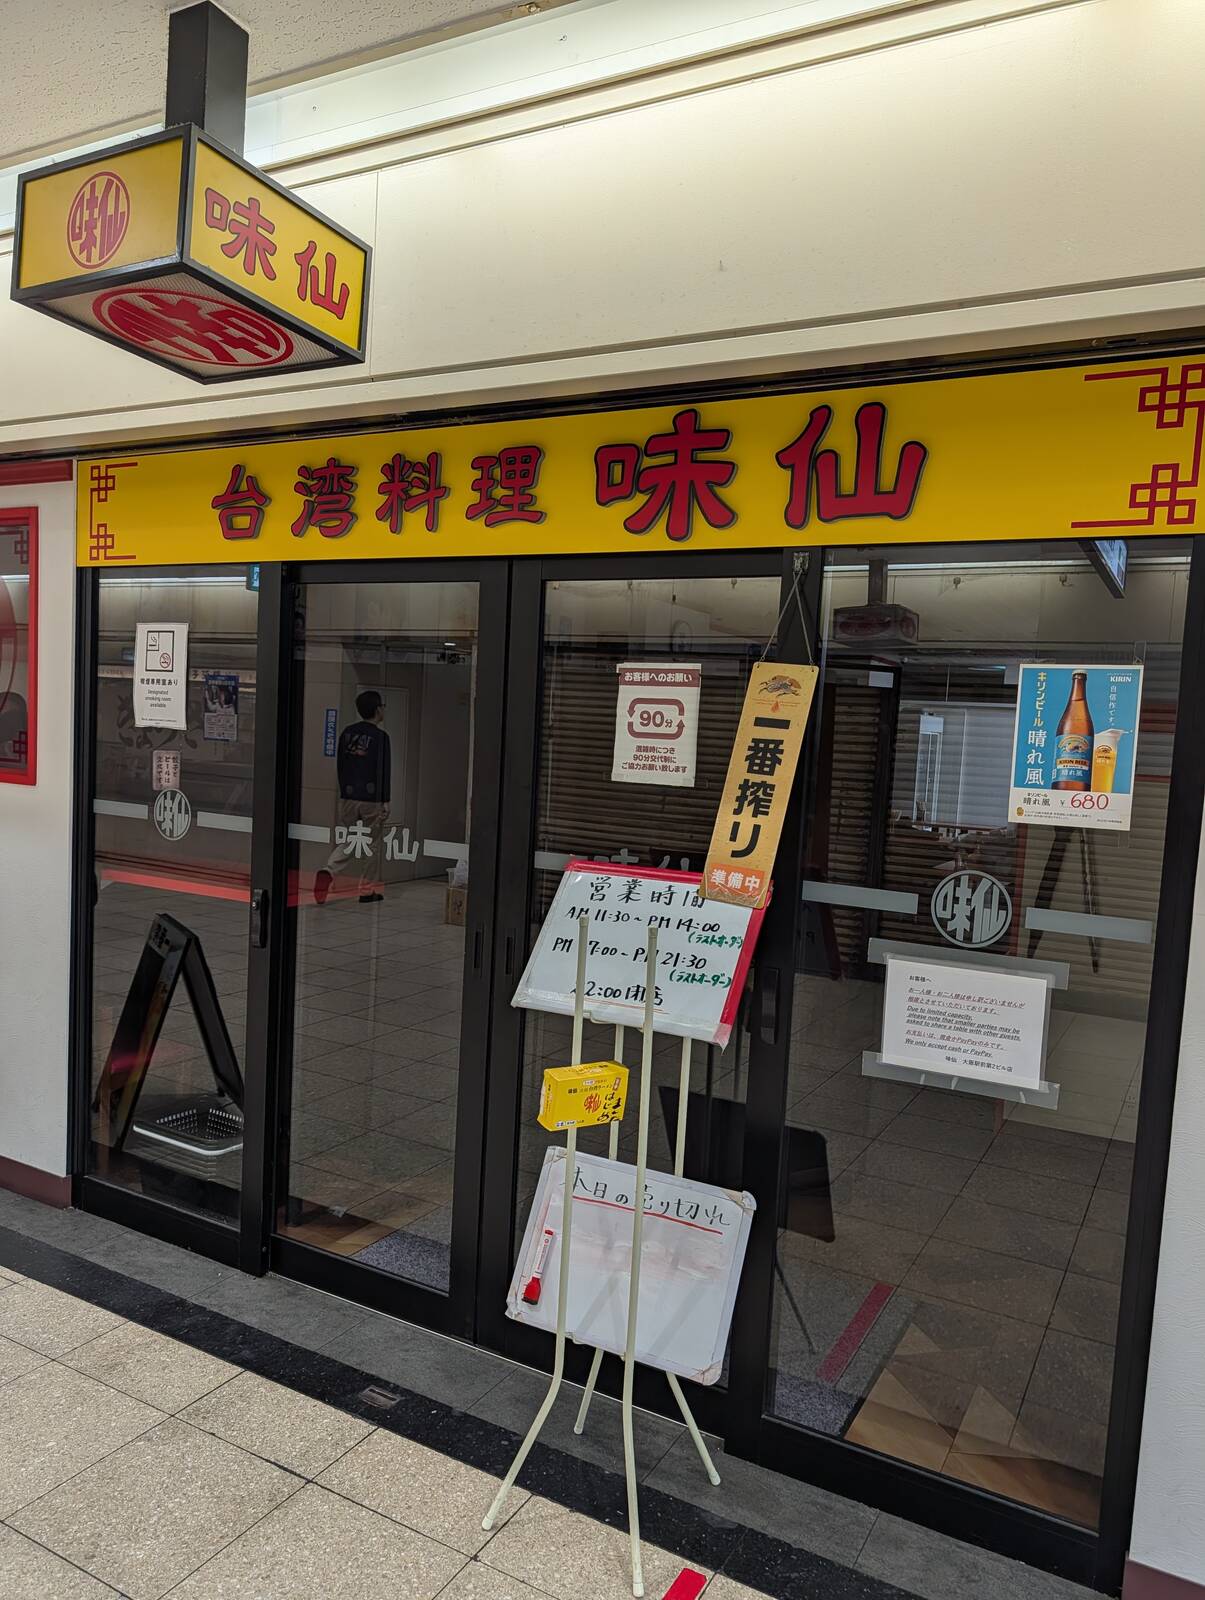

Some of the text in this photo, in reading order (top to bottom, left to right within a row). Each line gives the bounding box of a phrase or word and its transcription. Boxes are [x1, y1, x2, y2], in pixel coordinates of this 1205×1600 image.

[71, 174, 127, 264] 味仙
[203, 185, 350, 321] 味仙
[211, 401, 929, 543] 台湾料理 味仙
[624, 672, 692, 682] お客様へのお願い
[1110, 675, 1133, 683] KIRIN
[1033, 671, 1048, 727] キリンビール
[639, 710, 673, 728] 90分
[633, 754, 677, 764] 90分交代制に
[635, 745, 676, 754] 混雑時につき
[1024, 729, 1048, 786] 晴れ風
[621, 762, 688, 774] ご協力お願い致します
[729, 716, 791, 859] 一番搾り
[1023, 797, 1051, 807] 晴れ風
[1071, 793, 1109, 810] 680
[335, 820, 420, 862] 味仙
[711, 869, 760, 892] 準備中
[590, 876, 706, 909] 営業時間
[936, 874, 1008, 943] 味仙
[594, 909, 630, 922] 11:30
[648, 915, 672, 929] PM
[676, 918, 721, 934] 14:00
[552, 937, 573, 953] PM
[661, 952, 707, 970] 21:30
[909, 975, 932, 983] お客様へ
[927, 1008, 947, 1016] limited
[906, 1018, 923, 1026] asked
[931, 1021, 947, 1029] share
[953, 1025, 968, 1033] table
[969, 1027, 982, 1035] with
[983, 1029, 998, 1038] other
[907, 1013, 927, 1021] please
[955, 1019, 976, 1027] smaller
[977, 1022, 997, 1031] parties
[999, 1026, 1012, 1034] may
[915, 1039, 926, 1047] only
[927, 1042, 947, 1051] accept
[947, 1045, 961, 1053] cash
